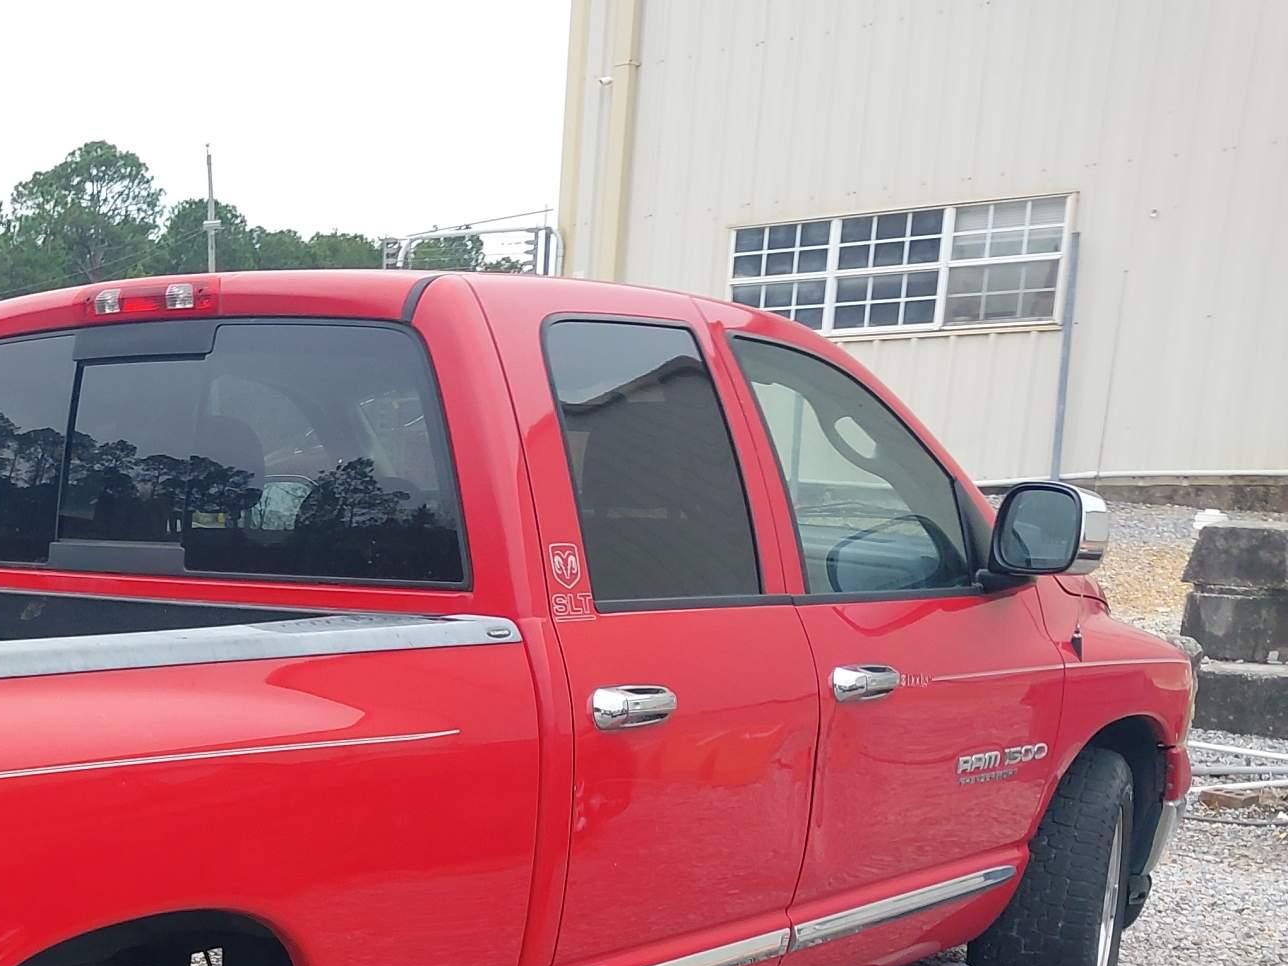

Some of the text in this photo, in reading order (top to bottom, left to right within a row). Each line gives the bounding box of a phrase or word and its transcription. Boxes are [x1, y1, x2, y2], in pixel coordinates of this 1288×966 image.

[552, 592, 593, 616] SLT
[957, 742, 1049, 774] RAM 1500
